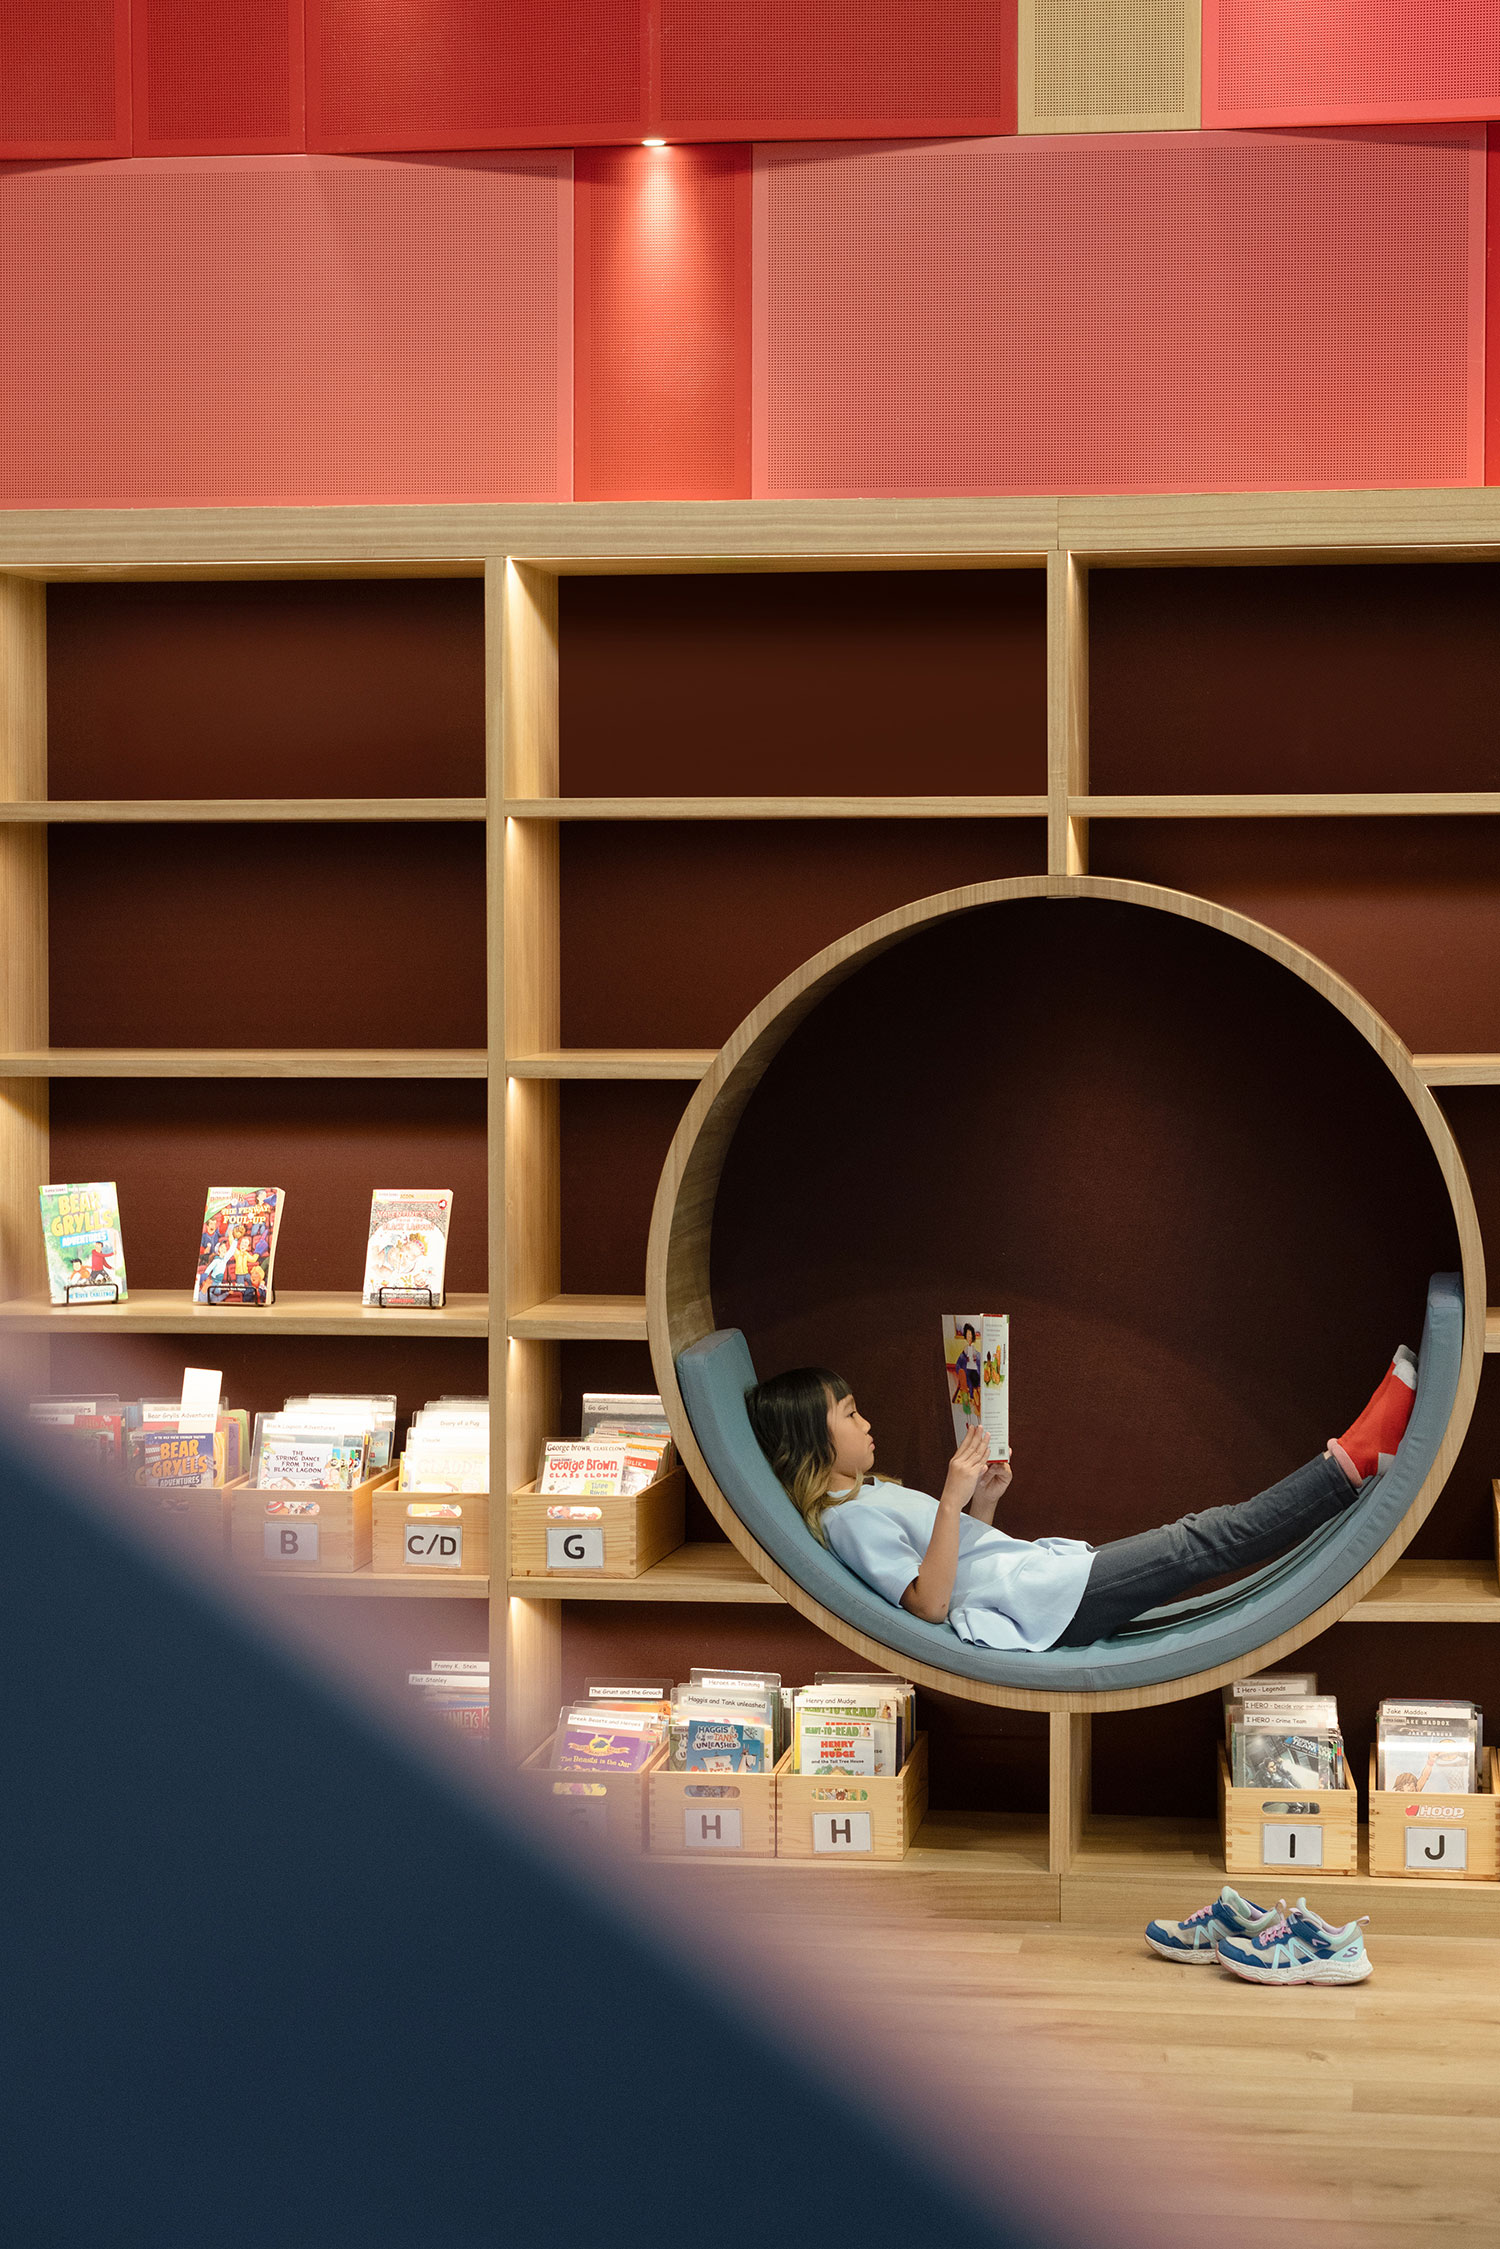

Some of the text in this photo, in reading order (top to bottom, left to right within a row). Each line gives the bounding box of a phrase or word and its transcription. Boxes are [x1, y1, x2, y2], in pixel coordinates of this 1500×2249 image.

[58, 1191, 102, 1216] BEAR
[51, 1209, 114, 1237] GRYLLS
[223, 1216, 266, 1224] FOUL-UP
[62, 1230, 106, 1247] ADVENTURES
[160, 1439, 199, 1460] BEAR
[547, 1444, 569, 1453] George
[152, 1456, 207, 1478] GRYLLS
[160, 1476, 200, 1487] ADVENTURES
[280, 1530, 299, 1554] B
[408, 1534, 457, 1556] C/D
[564, 1534, 585, 1559] G
[688, 1696, 708, 1704] Haggis
[714, 1733, 734, 1742] TANK
[573, 1756, 598, 1764] Beasts
[1420, 1806, 1465, 1818] HOOP
[701, 1814, 721, 1839] H
[831, 1819, 851, 1843] H
[1289, 1833, 1296, 1858] I
[1424, 1834, 1445, 1860] J
